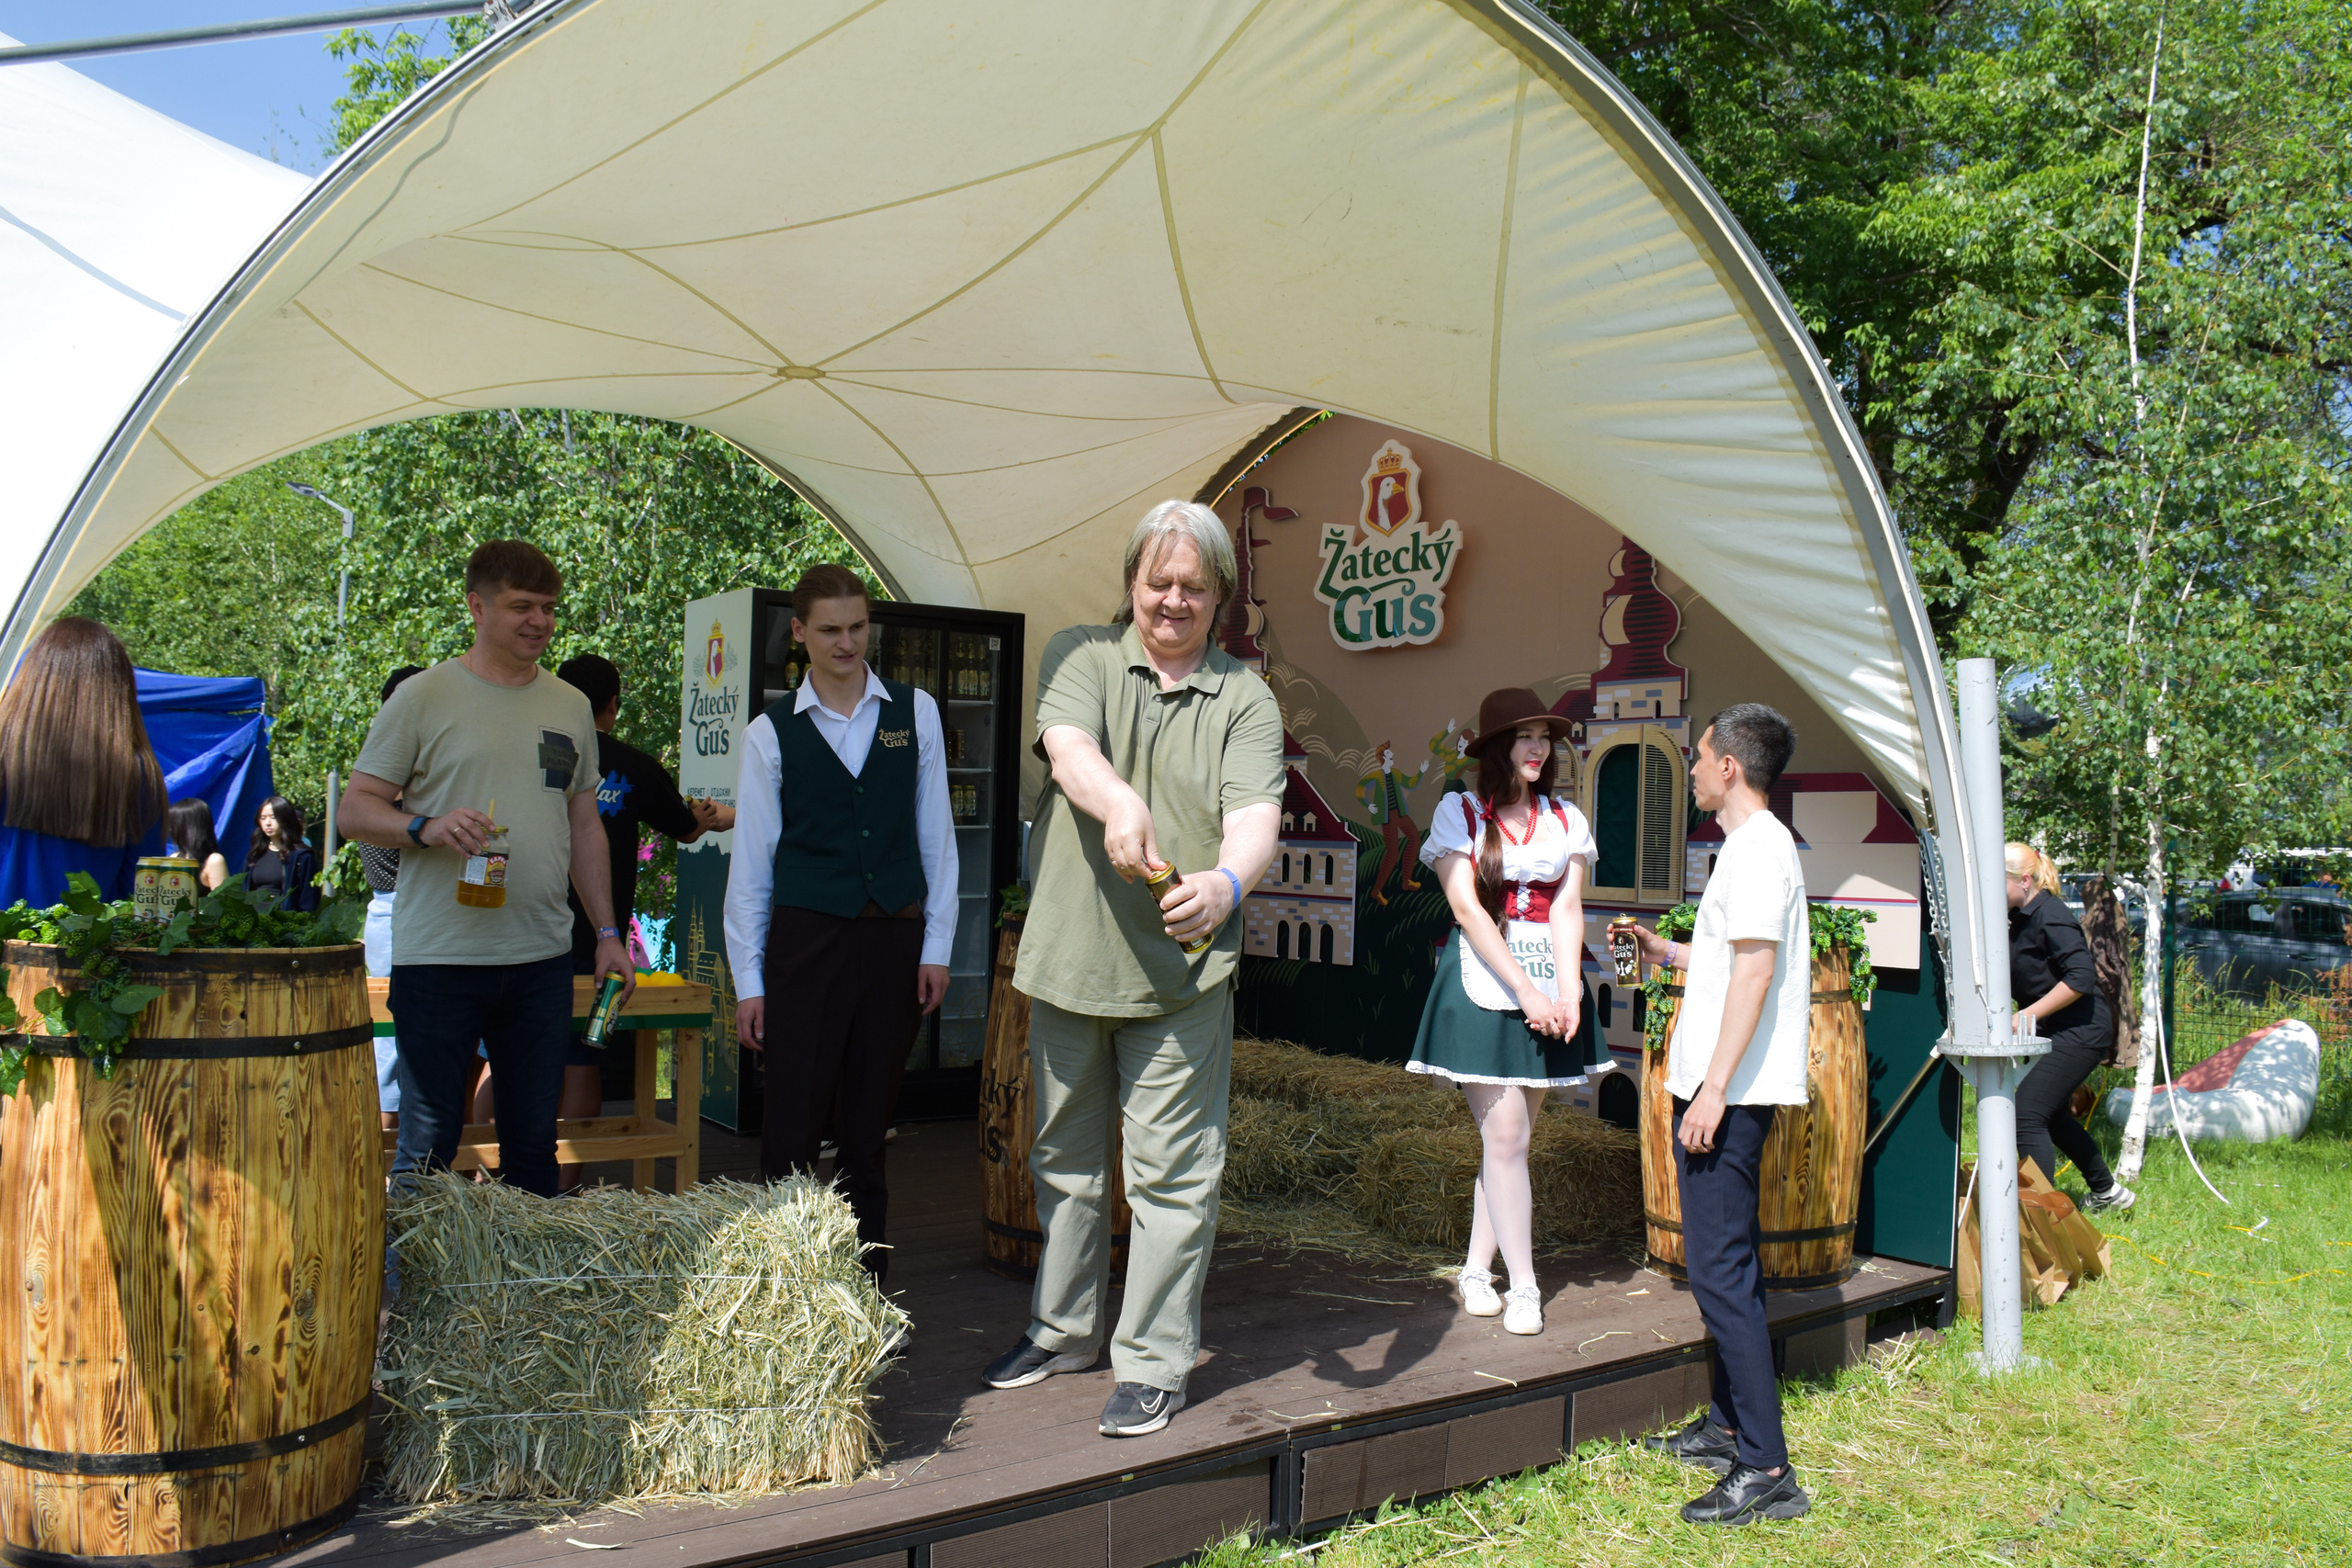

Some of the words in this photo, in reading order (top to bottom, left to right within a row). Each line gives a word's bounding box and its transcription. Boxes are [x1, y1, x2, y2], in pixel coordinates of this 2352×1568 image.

[1318, 527, 1454, 600] Žatecký
[1333, 585, 1436, 643] Gus
[688, 681, 740, 727] Žatecký
[695, 720, 729, 756] Gus
[878, 728, 910, 740] Žatecký
[1507, 937, 1554, 953] ateck
